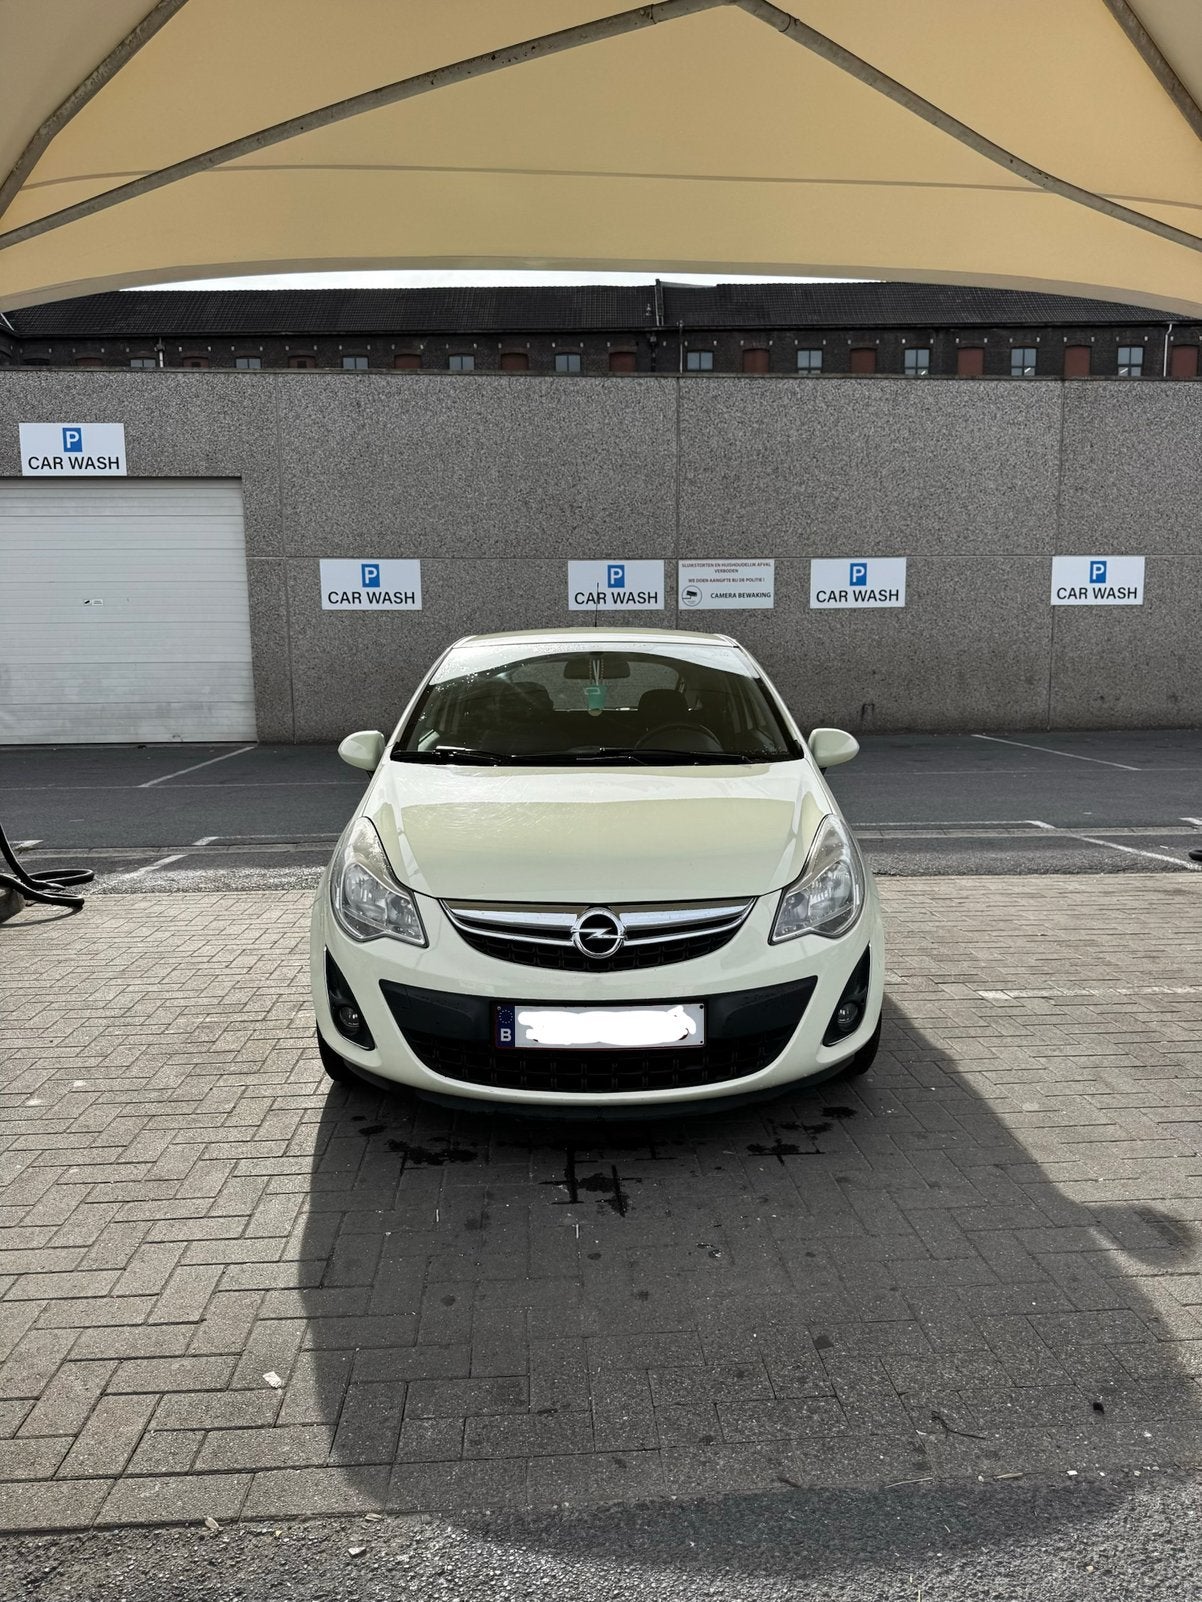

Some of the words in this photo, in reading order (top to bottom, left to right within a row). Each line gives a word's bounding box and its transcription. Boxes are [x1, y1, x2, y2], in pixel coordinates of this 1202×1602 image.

[65, 431, 79, 449] P
[28, 456, 64, 470] CAR
[68, 456, 120, 470] WASH
[364, 567, 377, 584] P
[610, 568, 622, 584] P
[852, 566, 865, 582] P
[1092, 564, 1104, 580] P
[328, 590, 362, 605] CAR
[366, 590, 416, 605] WASH
[574, 592, 607, 605] CAR
[611, 591, 658, 605] WASH
[816, 589, 849, 604] CAR
[853, 589, 900, 604] WASH
[1057, 587, 1088, 600] CAR
[1091, 586, 1138, 600] WASH
[500, 1028, 512, 1042] B
